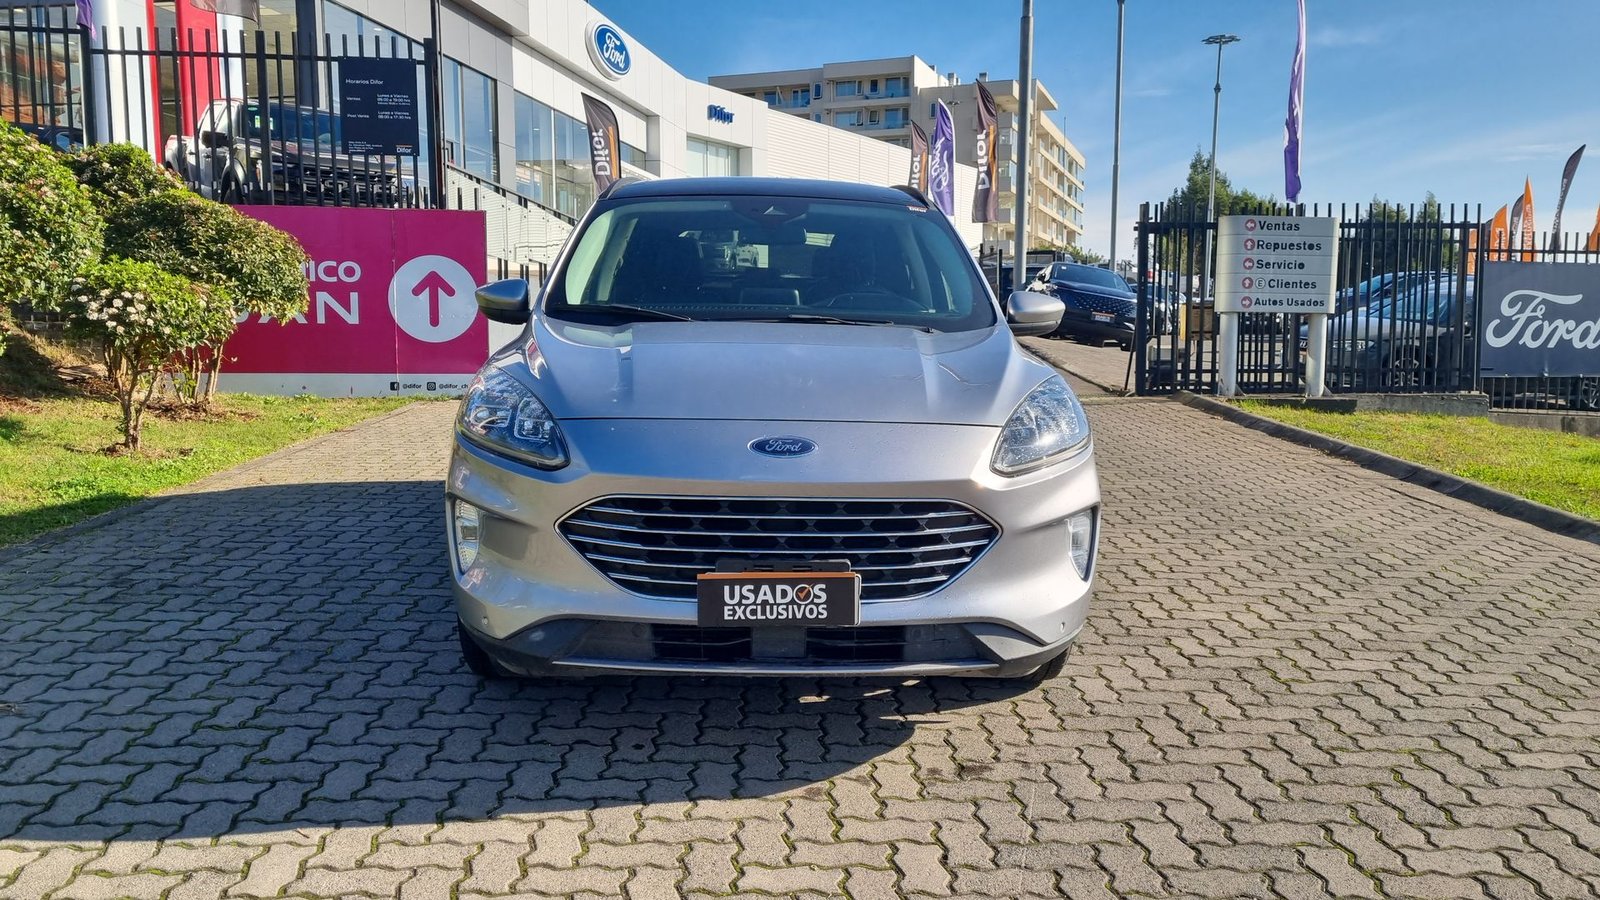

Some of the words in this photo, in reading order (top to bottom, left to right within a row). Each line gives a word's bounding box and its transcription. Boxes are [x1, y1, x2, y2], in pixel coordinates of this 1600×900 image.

[603, 32, 626, 69] Ford
[706, 104, 735, 124] Difor
[1258, 221, 1300, 231] Ventas
[1256, 240, 1322, 252] Repuestos
[1256, 260, 1305, 270] Servicio
[1268, 279, 1317, 289] Clientes
[1254, 298, 1284, 306] Autos
[1287, 298, 1325, 306] Usados
[1486, 290, 1600, 349] Ford
[765, 440, 802, 451] Ford
[723, 584, 827, 604] USADOS
[723, 604, 828, 620] EXCLUSIVOS
